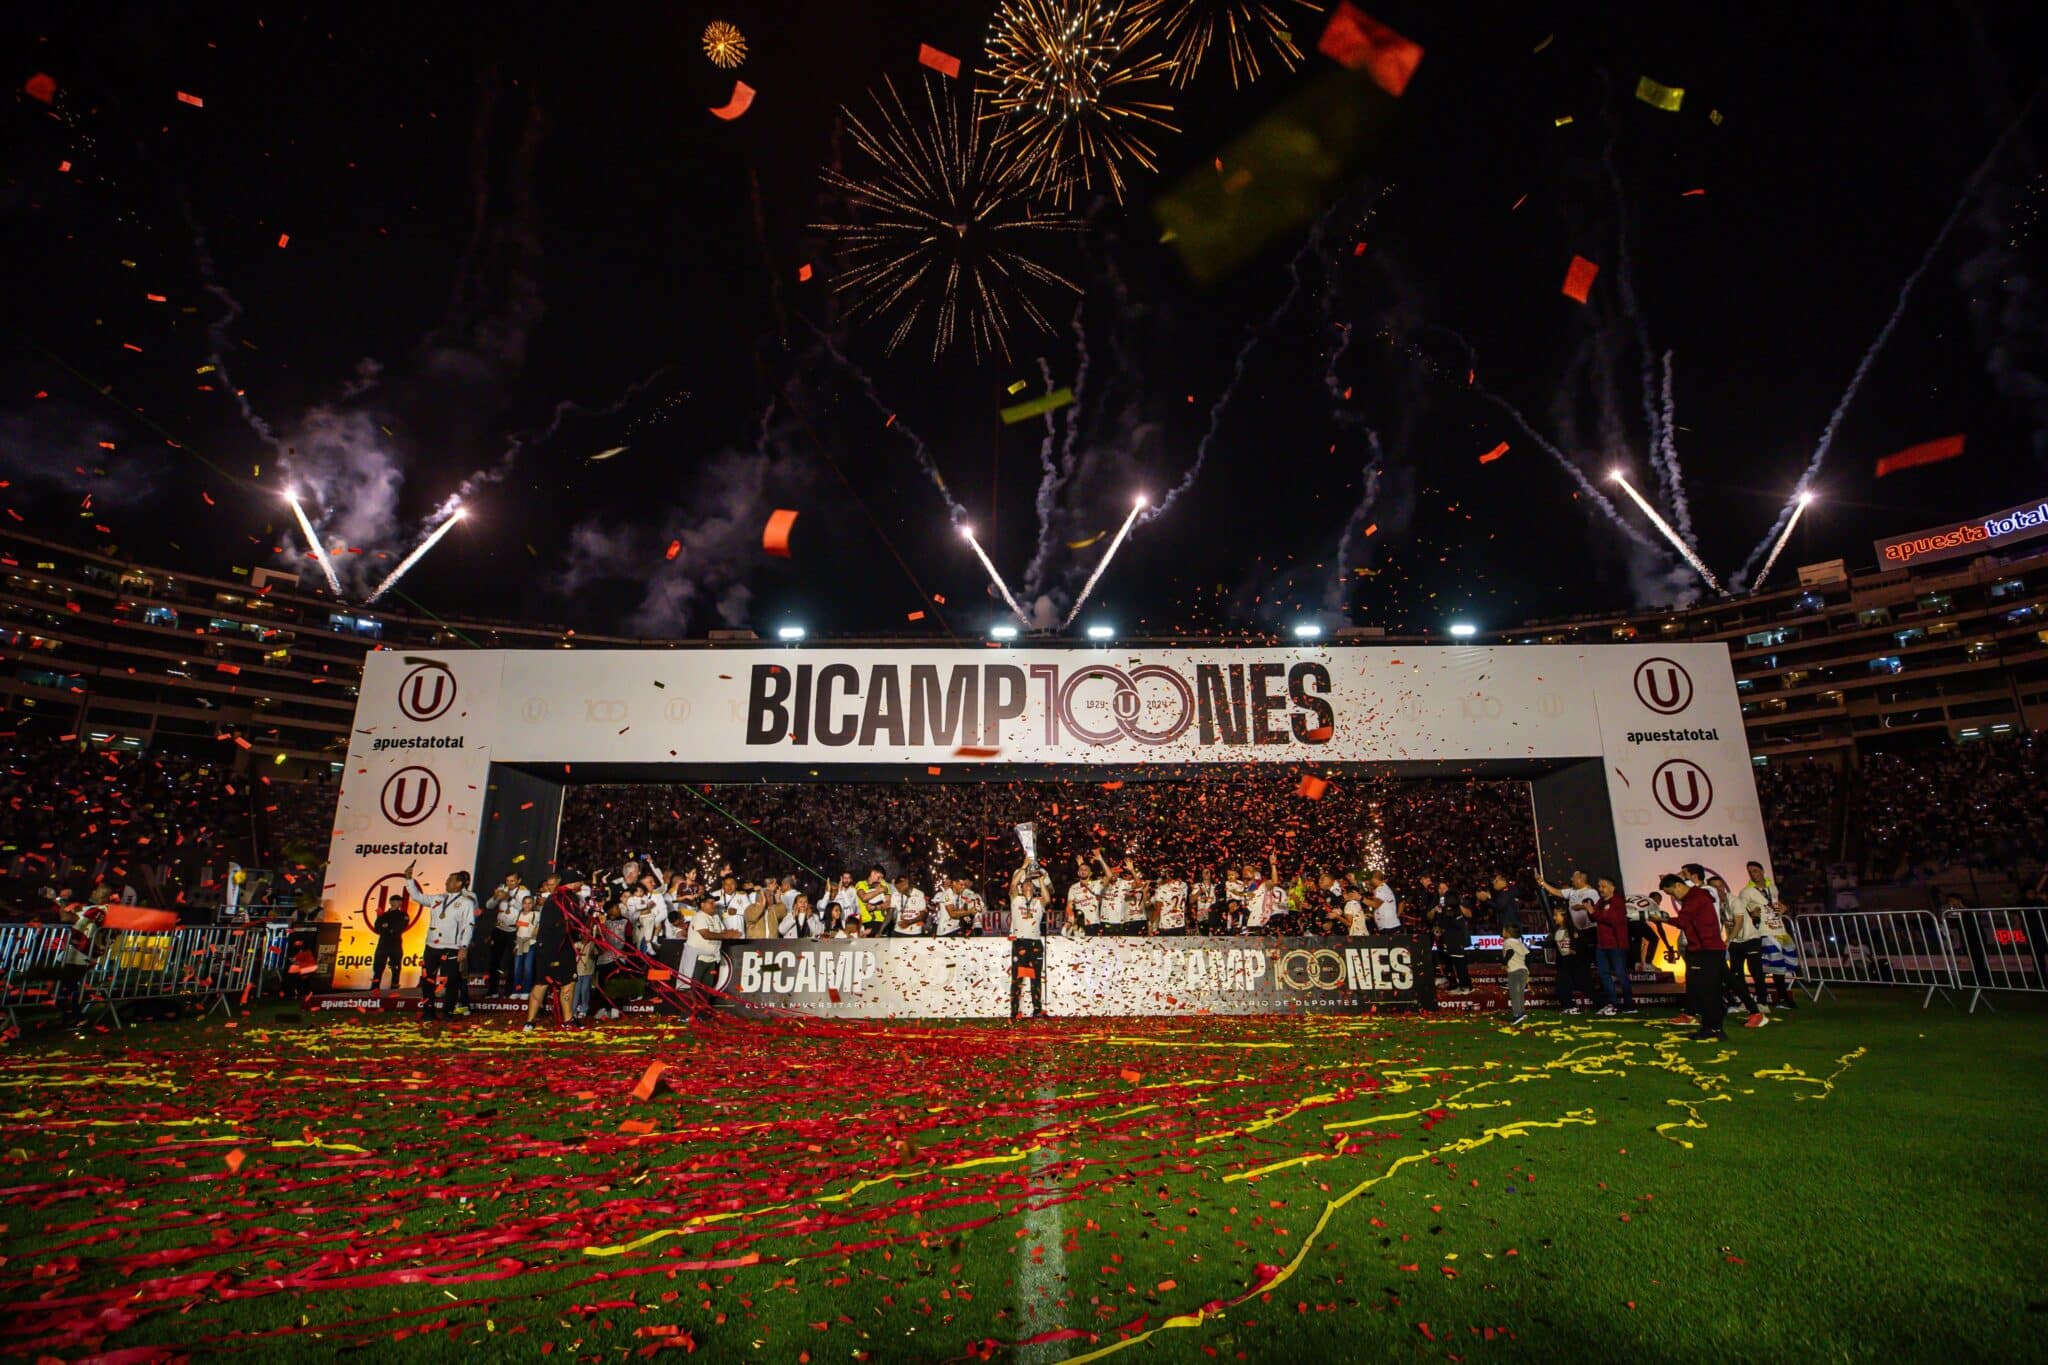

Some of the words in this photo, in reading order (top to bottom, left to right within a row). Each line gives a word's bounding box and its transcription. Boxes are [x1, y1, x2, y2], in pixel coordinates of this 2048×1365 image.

[411, 675, 445, 715] U
[1646, 669, 1681, 708] U
[373, 736, 464, 751] apuestatotal
[1627, 728, 1719, 745] apuestatotal
[394, 778, 428, 819] U
[1664, 771, 1700, 813] U
[355, 842, 448, 858] apuestatotal
[1645, 834, 1739, 851] apuestatotal
[321, 999, 381, 1010] apuestatotal
